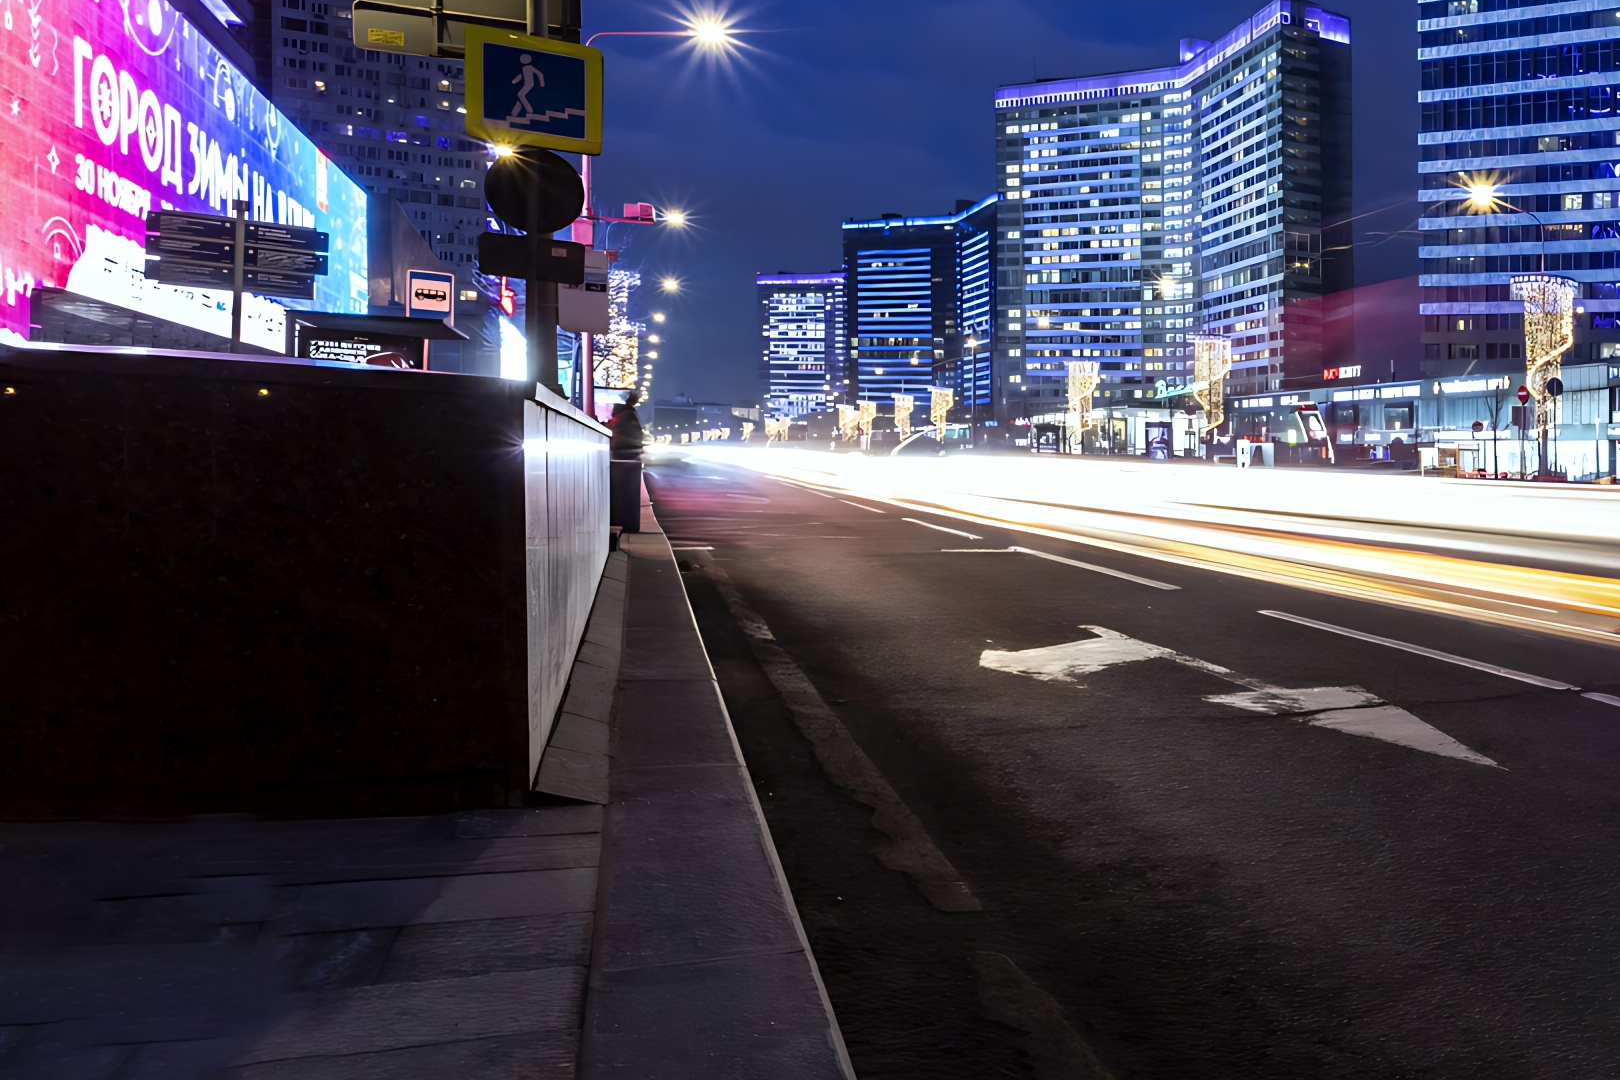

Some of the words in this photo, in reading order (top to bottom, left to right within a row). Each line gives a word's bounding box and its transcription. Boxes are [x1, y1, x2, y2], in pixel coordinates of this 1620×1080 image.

[73, 34, 183, 195] ГОРОД
[187, 121, 249, 220] ЗИМЫ
[75, 153, 95, 195] 30
